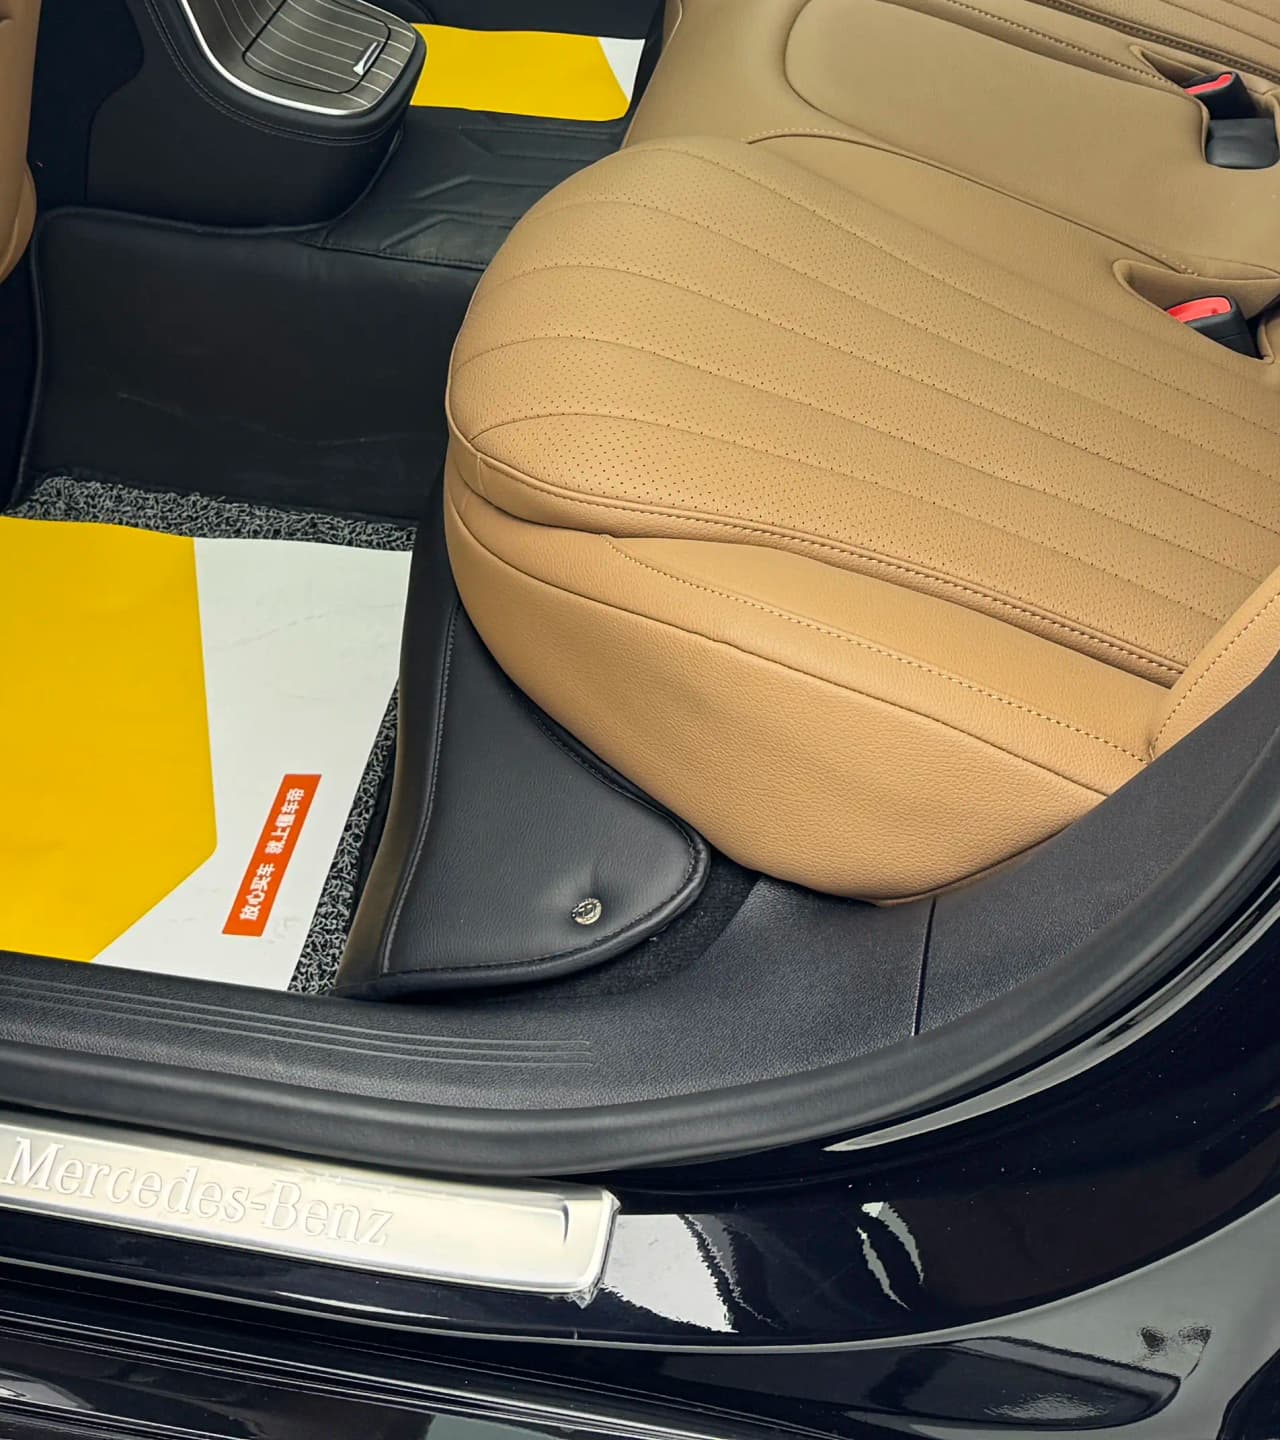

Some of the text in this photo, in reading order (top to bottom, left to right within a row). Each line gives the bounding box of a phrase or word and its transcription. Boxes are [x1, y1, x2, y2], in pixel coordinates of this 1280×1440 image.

[239, 863, 275, 921] 放心买车
[0, 1136, 393, 1246] Mercedes-Benz
